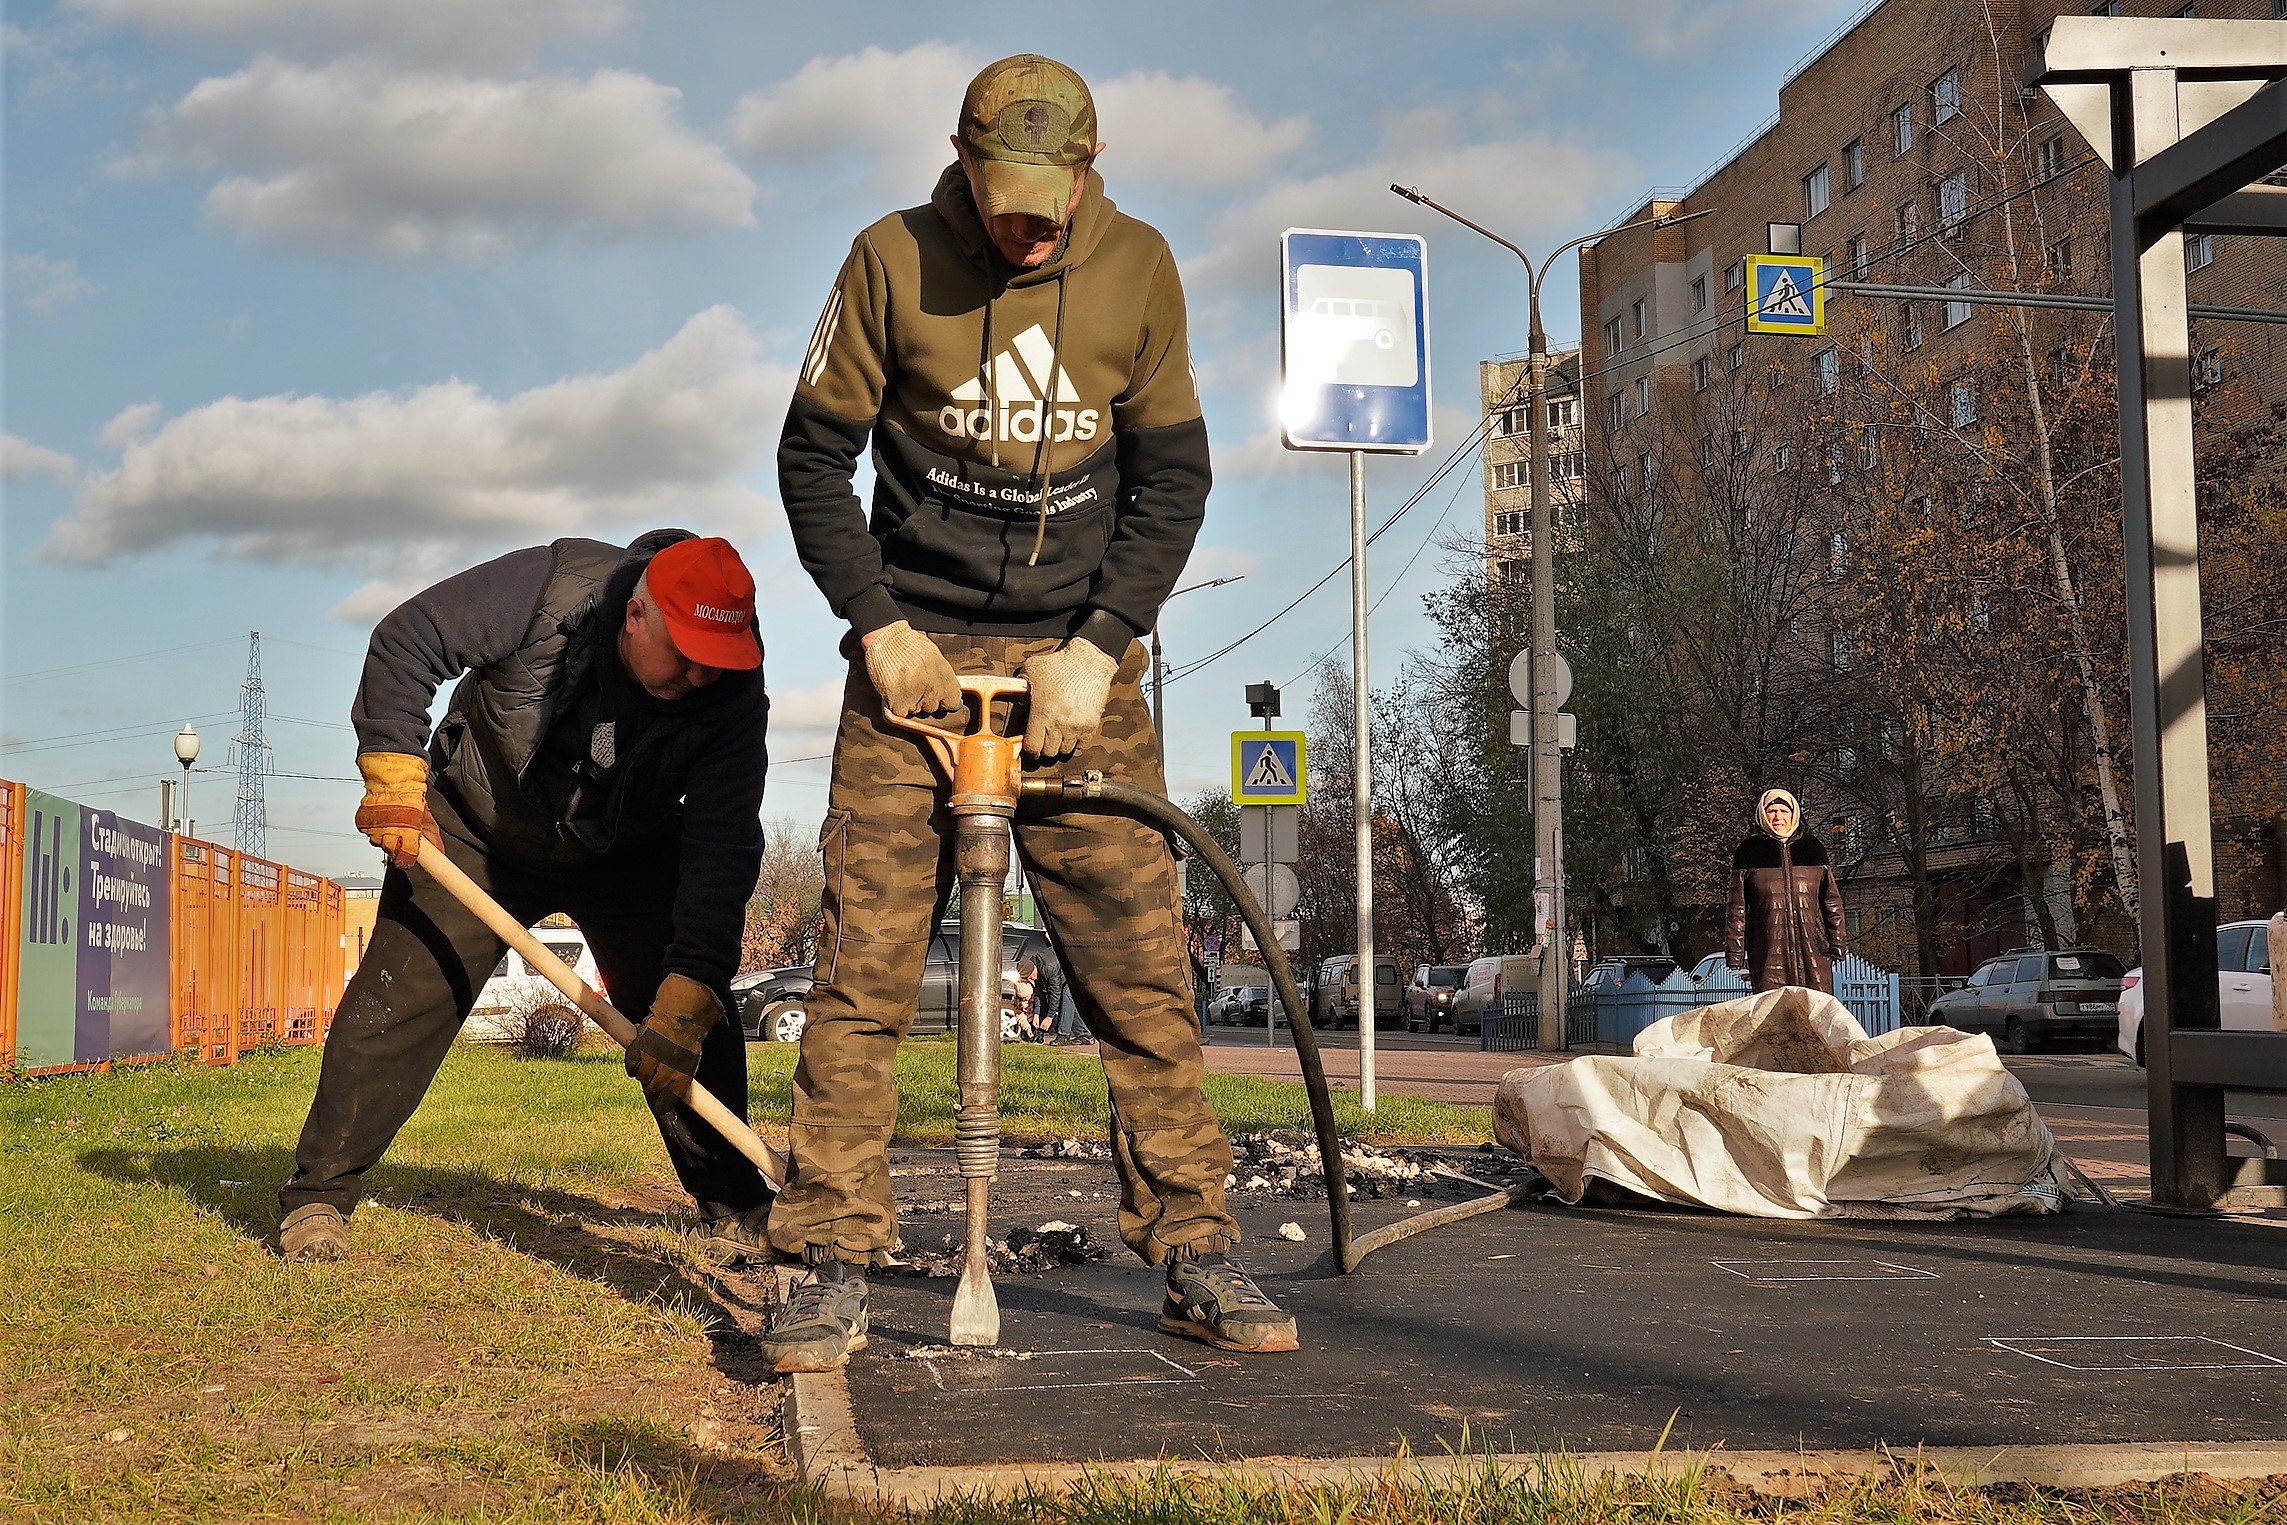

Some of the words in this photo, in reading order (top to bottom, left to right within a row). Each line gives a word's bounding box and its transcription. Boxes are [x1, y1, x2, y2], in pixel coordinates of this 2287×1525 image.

[939, 399, 1099, 443] adidas
[926, 467, 970, 492] Adidas
[973, 481, 986, 496] Is
[989, 489, 998, 499] a
[1000, 487, 1044, 505] Global
[1046, 480, 1080, 498] Leader
[1053, 487, 1098, 512] Industry
[130, 834, 163, 873] открыт!
[90, 860, 151, 914] Тренируйтесь
[88, 921, 102, 947] на
[104, 917, 147, 959] здоровье!
